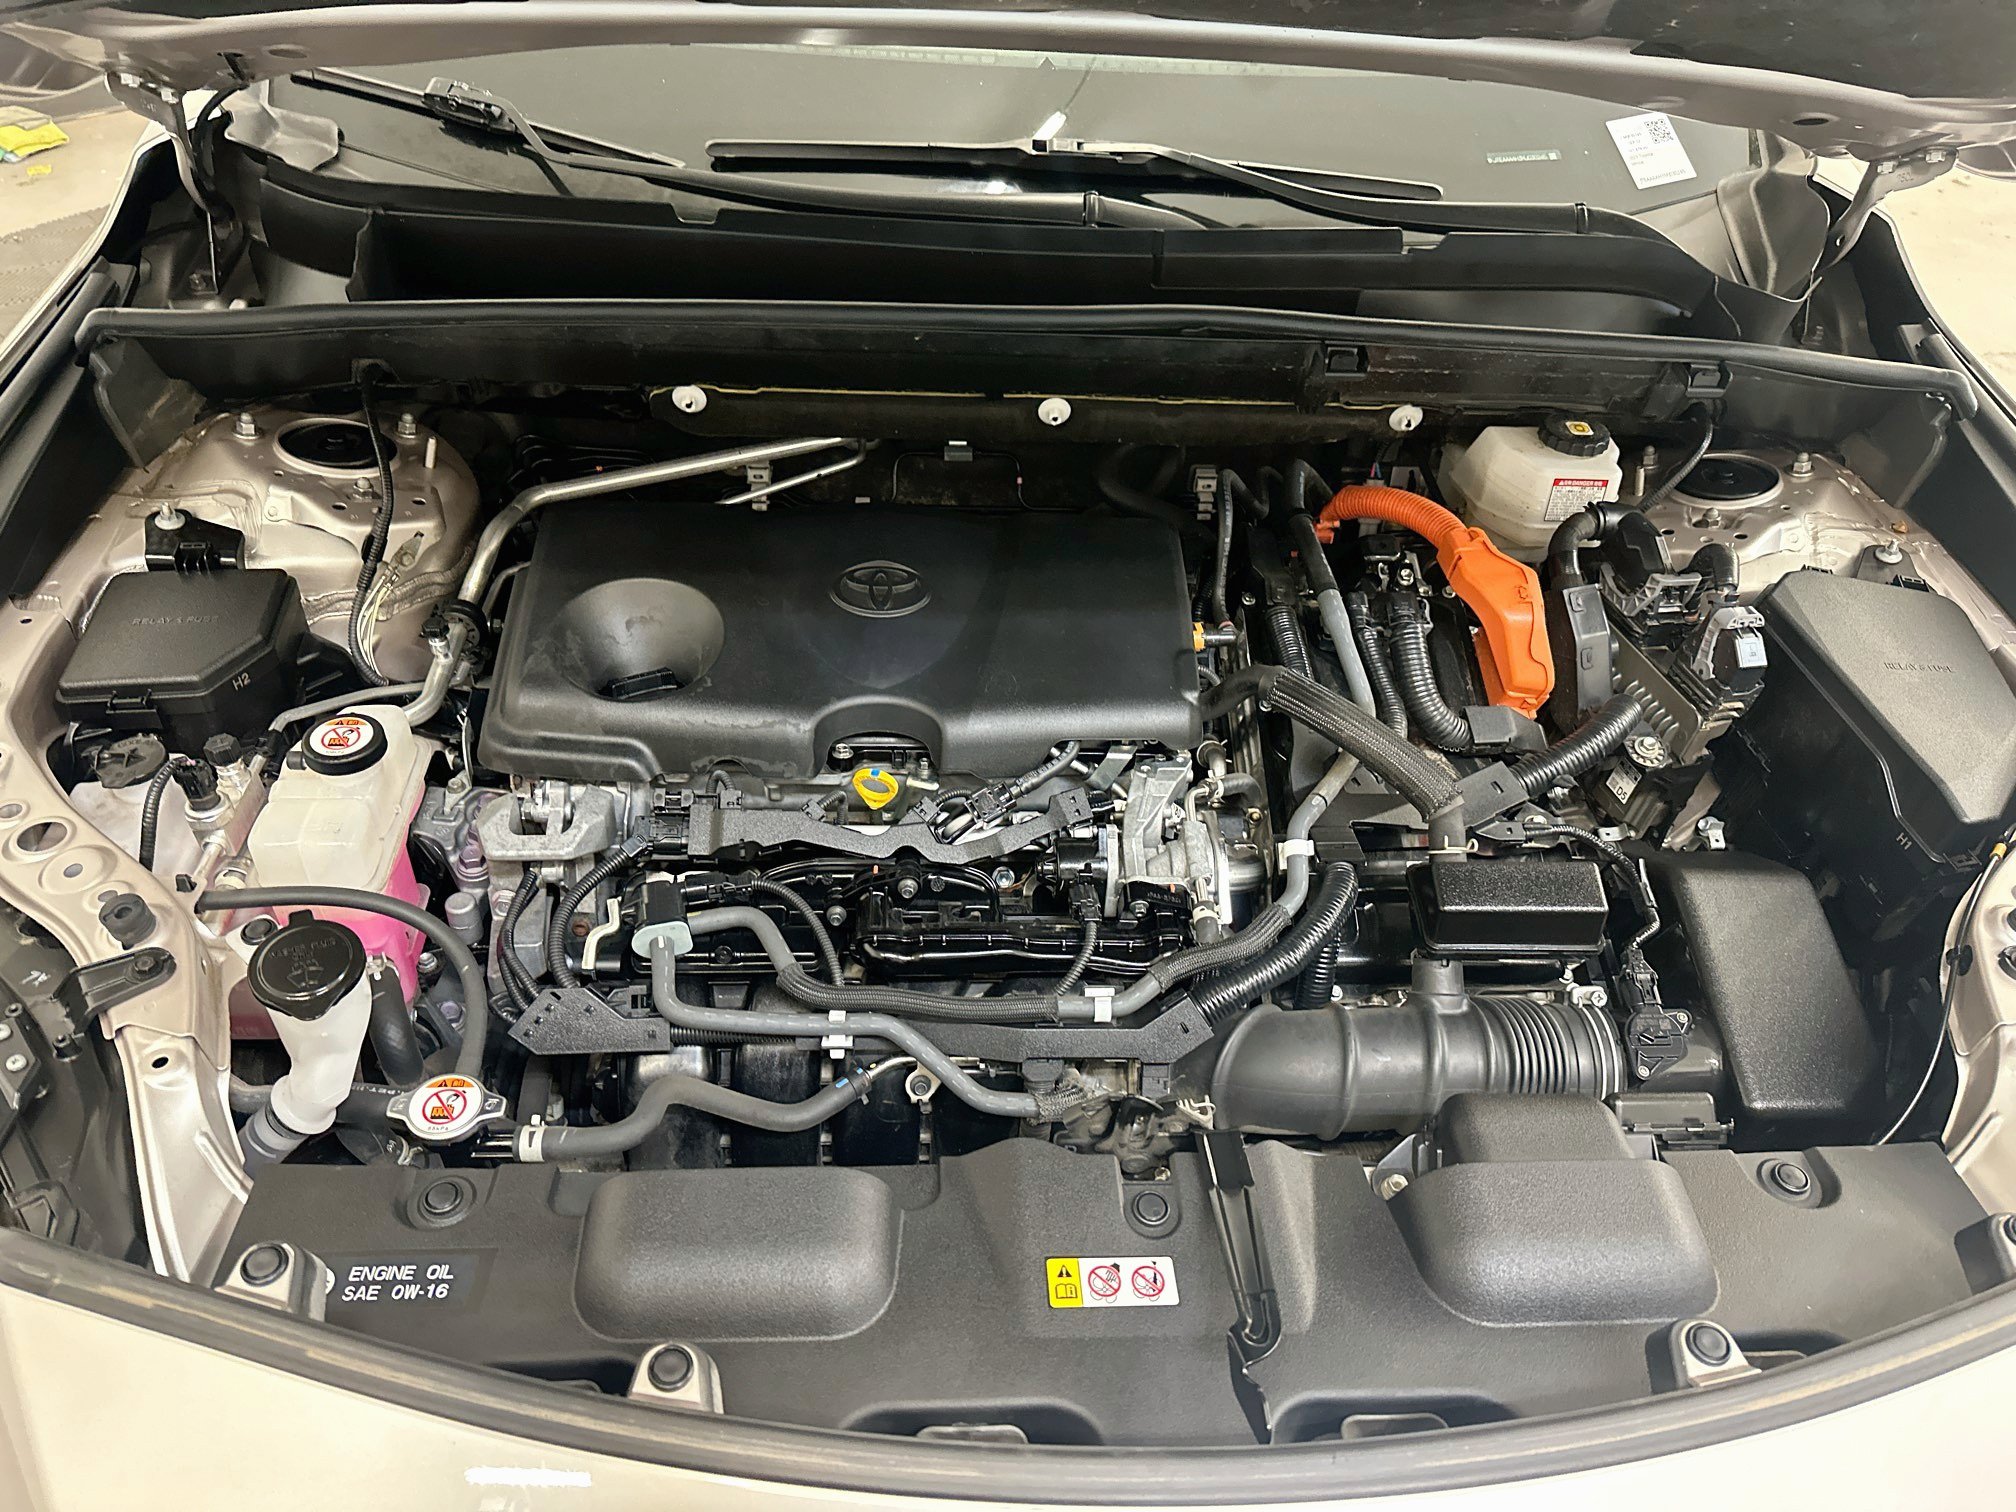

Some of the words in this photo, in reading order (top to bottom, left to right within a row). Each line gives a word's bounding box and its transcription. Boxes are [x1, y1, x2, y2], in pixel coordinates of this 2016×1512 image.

[130, 617, 171, 626] RELAY
[186, 615, 219, 623] FUSE
[1883, 662, 1917, 671] RELAY
[1927, 664, 1956, 674] FUSE
[231, 672, 251, 691] H2
[1616, 786, 1628, 801] D5
[1896, 832, 1912, 850] H1
[348, 1265, 417, 1281] ENGINE
[426, 1264, 454, 1280] OIL
[341, 1285, 382, 1301] SAE
[391, 1283, 450, 1300] 0W-16
